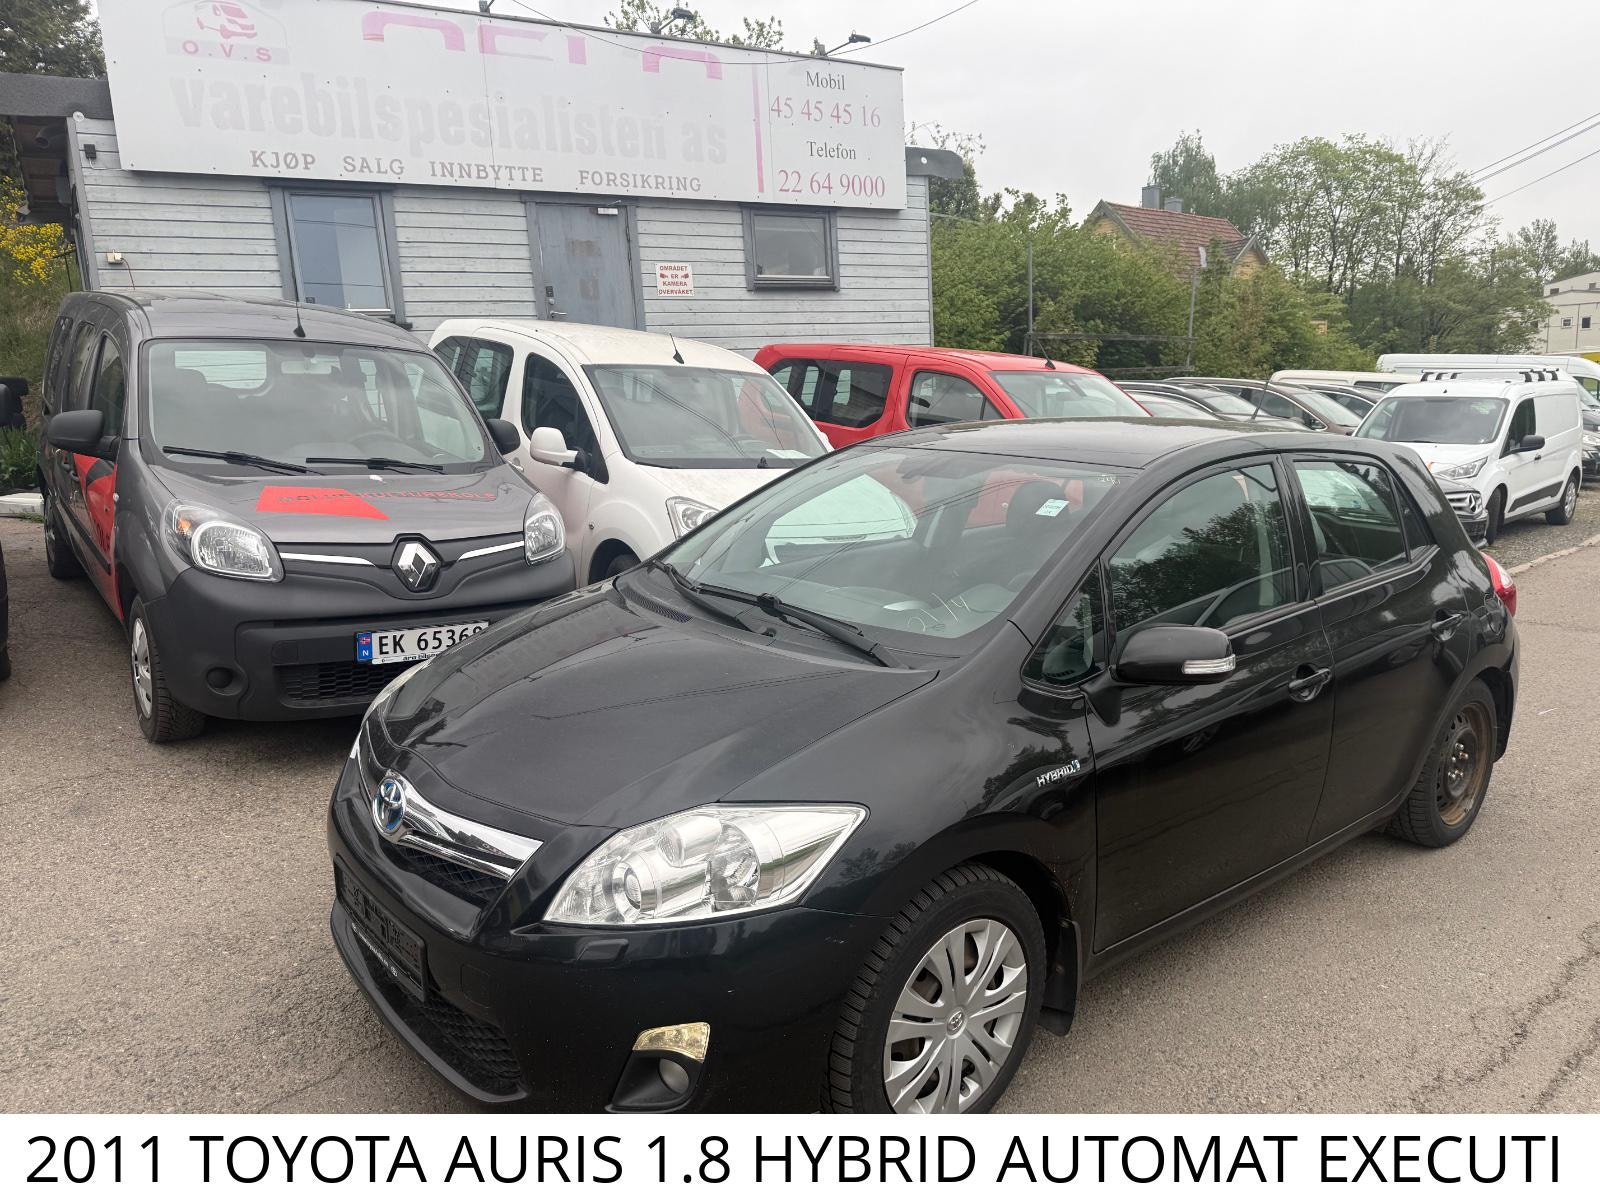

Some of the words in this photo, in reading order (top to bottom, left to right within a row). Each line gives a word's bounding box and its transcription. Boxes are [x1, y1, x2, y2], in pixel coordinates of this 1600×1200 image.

[806, 71, 845, 90] Mobil
[770, 95, 794, 119] 45
[800, 99, 823, 122] 45
[830, 101, 852, 125] 45
[860, 105, 881, 128] 16
[806, 140, 857, 160] Telefon
[249, 150, 317, 170] KJØP
[342, 155, 406, 176] SALG
[429, 160, 544, 183] INNBYTTE
[578, 170, 702, 193] FORSIKRING
[778, 169, 803, 193] 22
[809, 171, 833, 195] 64
[840, 173, 886, 198] 9000
[378, 634, 406, 656] EK
[1036, 763, 1074, 788] HYBRID
